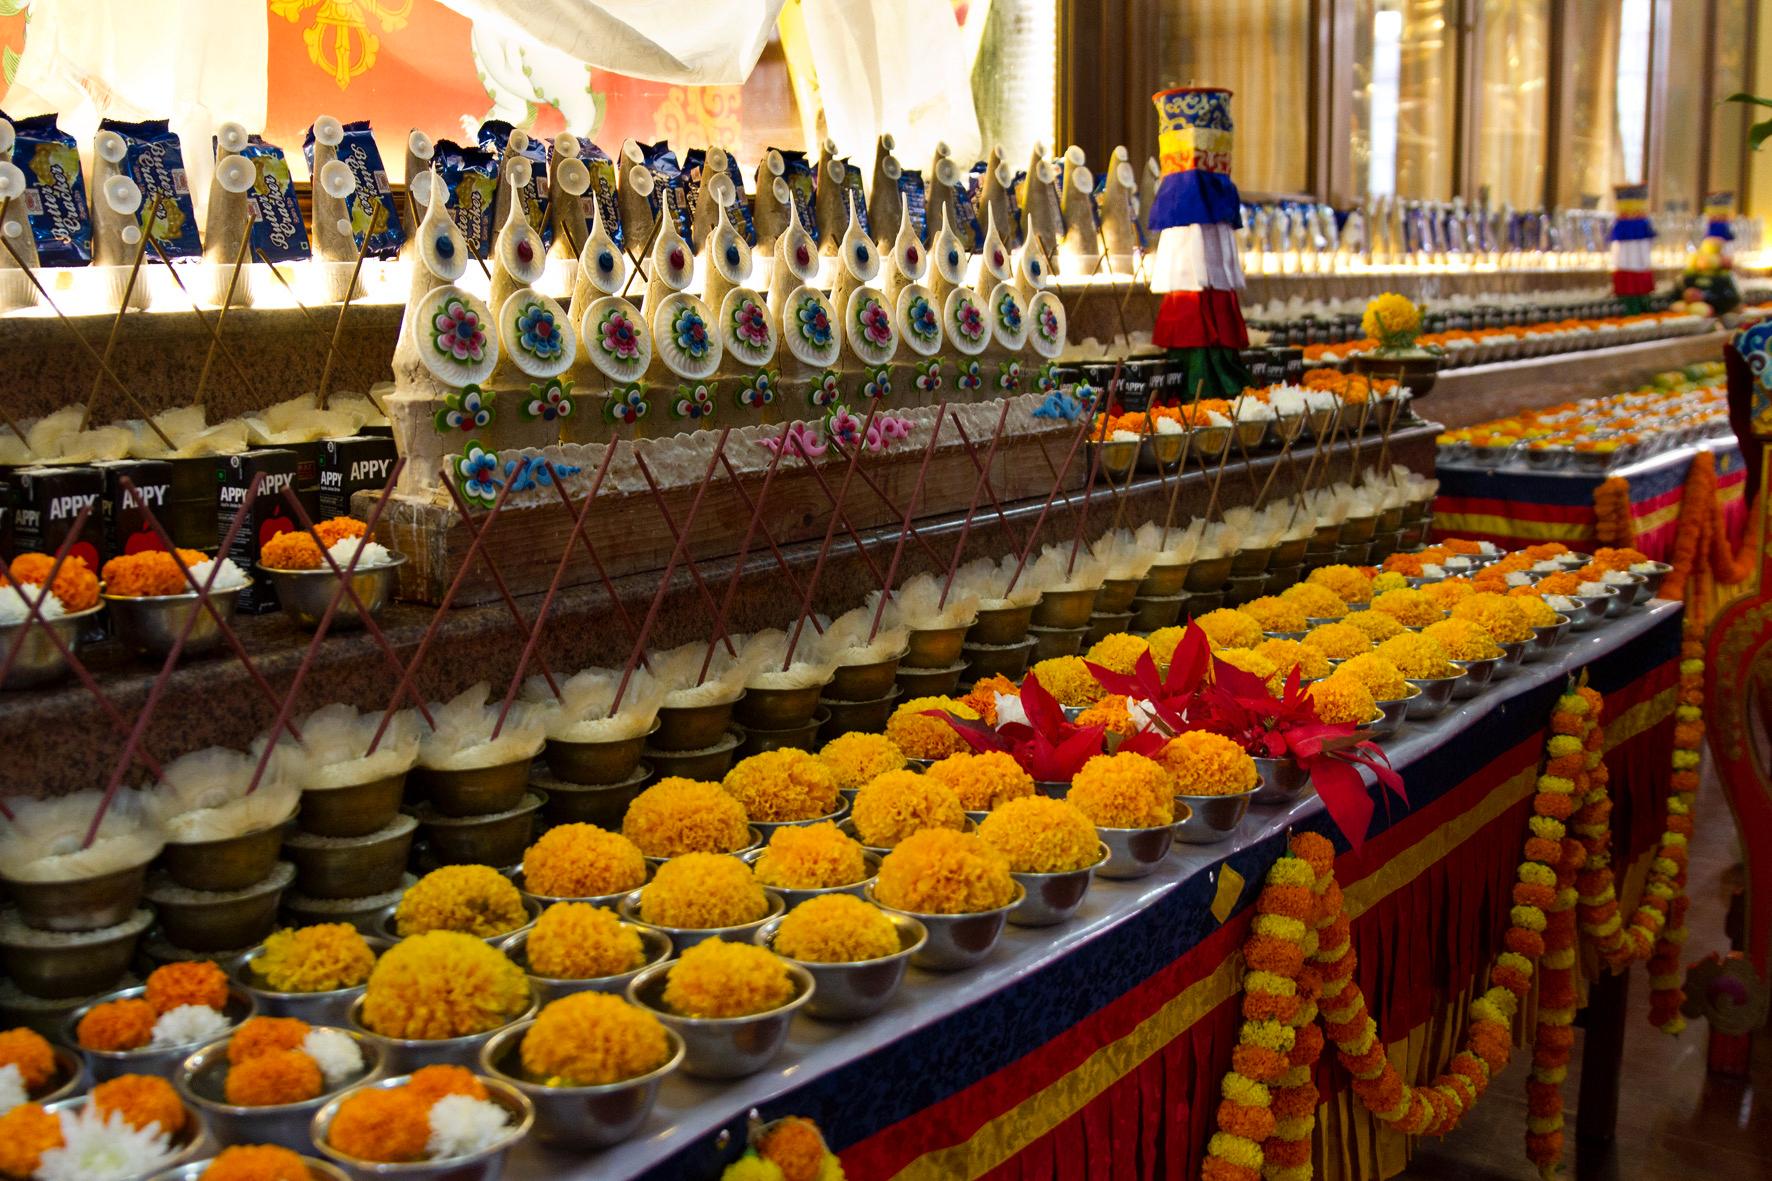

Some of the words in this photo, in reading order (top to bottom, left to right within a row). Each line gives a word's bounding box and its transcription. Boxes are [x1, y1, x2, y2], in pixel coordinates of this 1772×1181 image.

[139, 150, 168, 220] Cracer
[148, 141, 175, 199] Butter
[350, 143, 379, 198] Butter
[41, 184, 71, 243] Butter
[50, 164, 82, 233] Cracker
[260, 194, 289, 250] Butter
[265, 174, 297, 237] Cracker
[598, 177, 619, 232] Cracker
[220, 486, 248, 503] APPY
[257, 472, 294, 496] APPY
[320, 470, 343, 487] APPY
[350, 458, 390, 481] APPY
[15, 509, 40, 527] APPY
[50, 494, 96, 520] APPY
